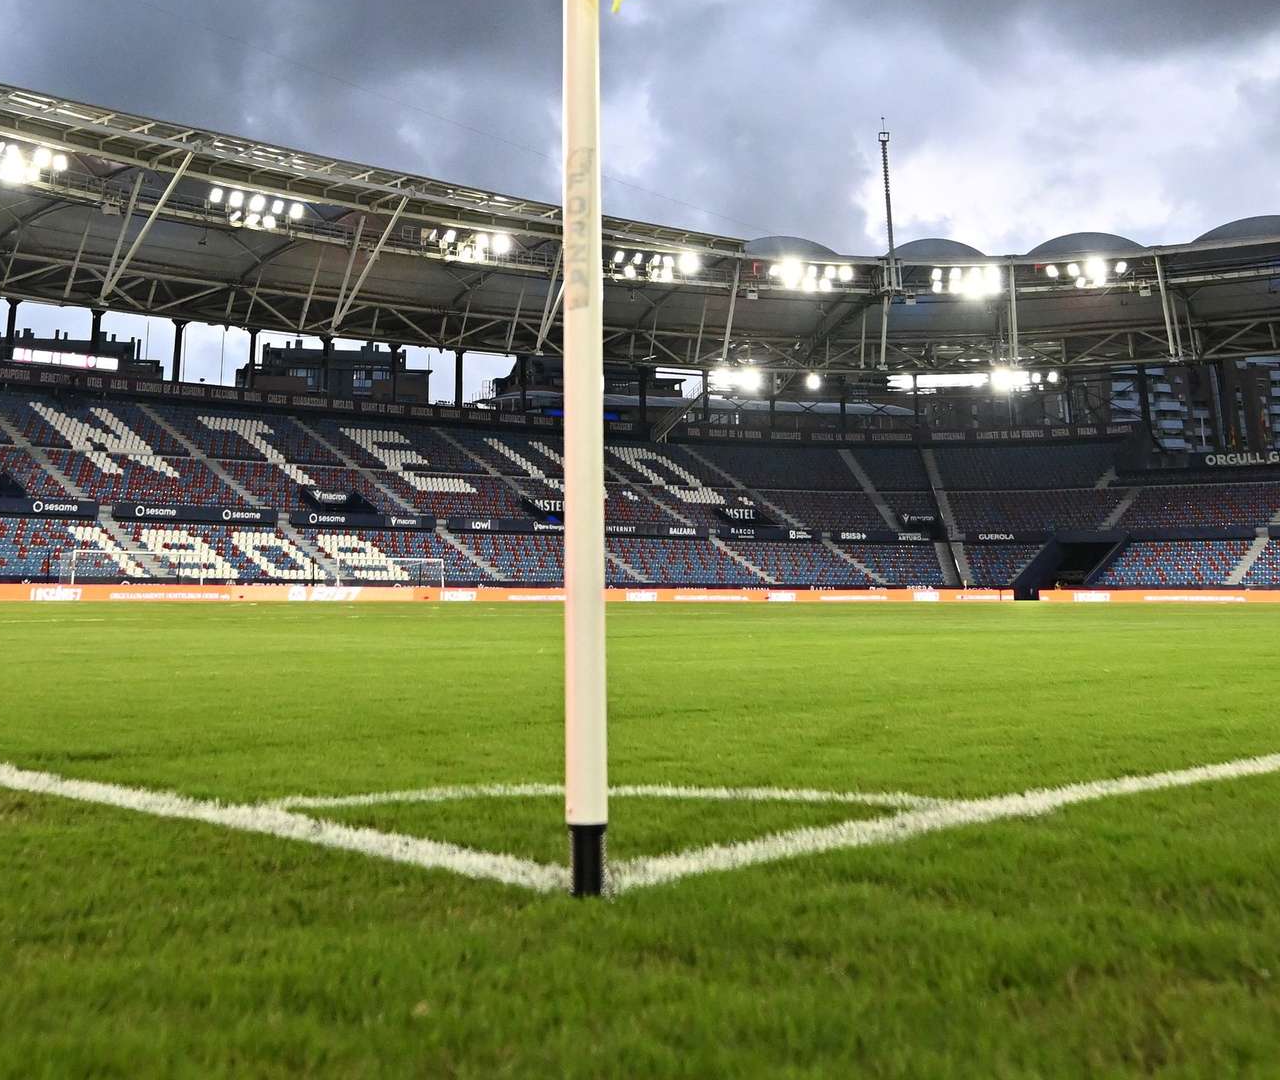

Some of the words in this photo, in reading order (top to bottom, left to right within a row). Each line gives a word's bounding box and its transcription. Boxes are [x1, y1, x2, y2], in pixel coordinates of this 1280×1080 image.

[1205, 453, 1265, 466] ORGULL
[321, 491, 348, 502] macron
[44, 502, 79, 513] sesame
[529, 499, 564, 512] MSTE
[145, 506, 177, 517] sesame
[232, 511, 262, 521] sesame
[318, 514, 346, 524] sesame
